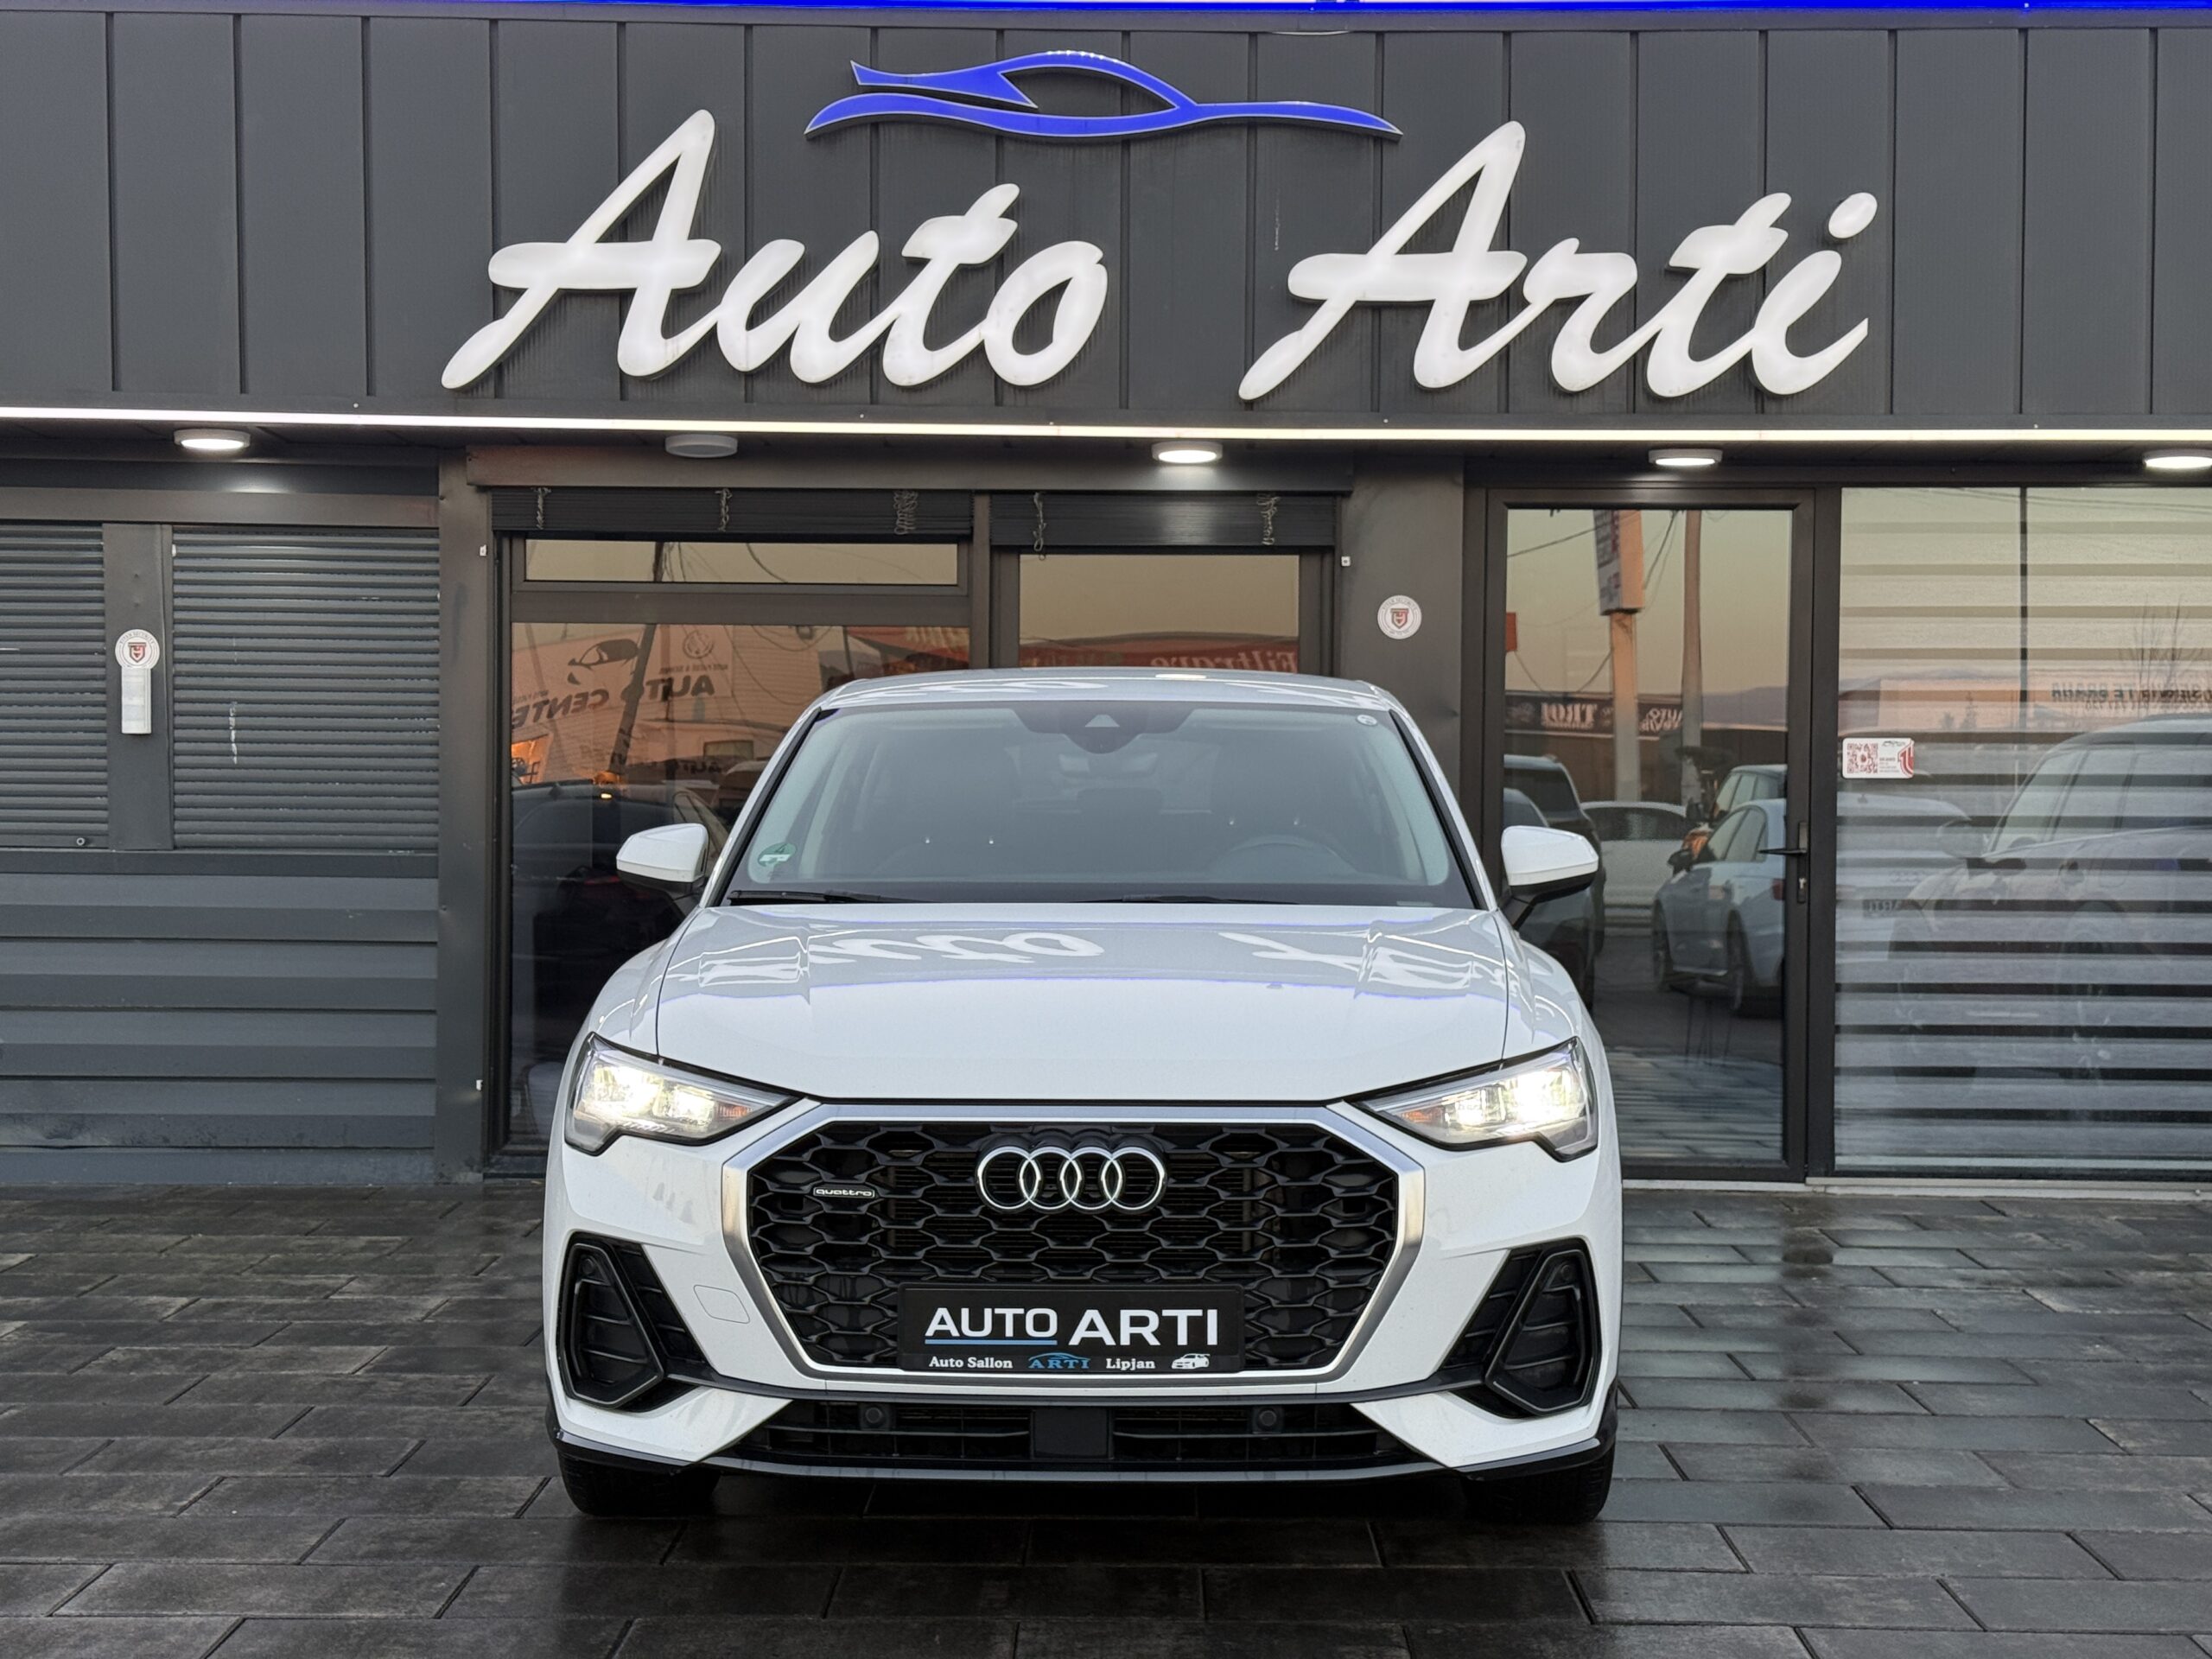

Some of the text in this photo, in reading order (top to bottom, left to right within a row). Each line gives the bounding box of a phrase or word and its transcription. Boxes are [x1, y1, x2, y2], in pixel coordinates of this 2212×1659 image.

[442, 110, 1878, 400] Auto Arti
[925, 1307, 1218, 1346] AUTO ARTI
[929, 1356, 1156, 1370] Auto Sallon ARTI Lipjan
